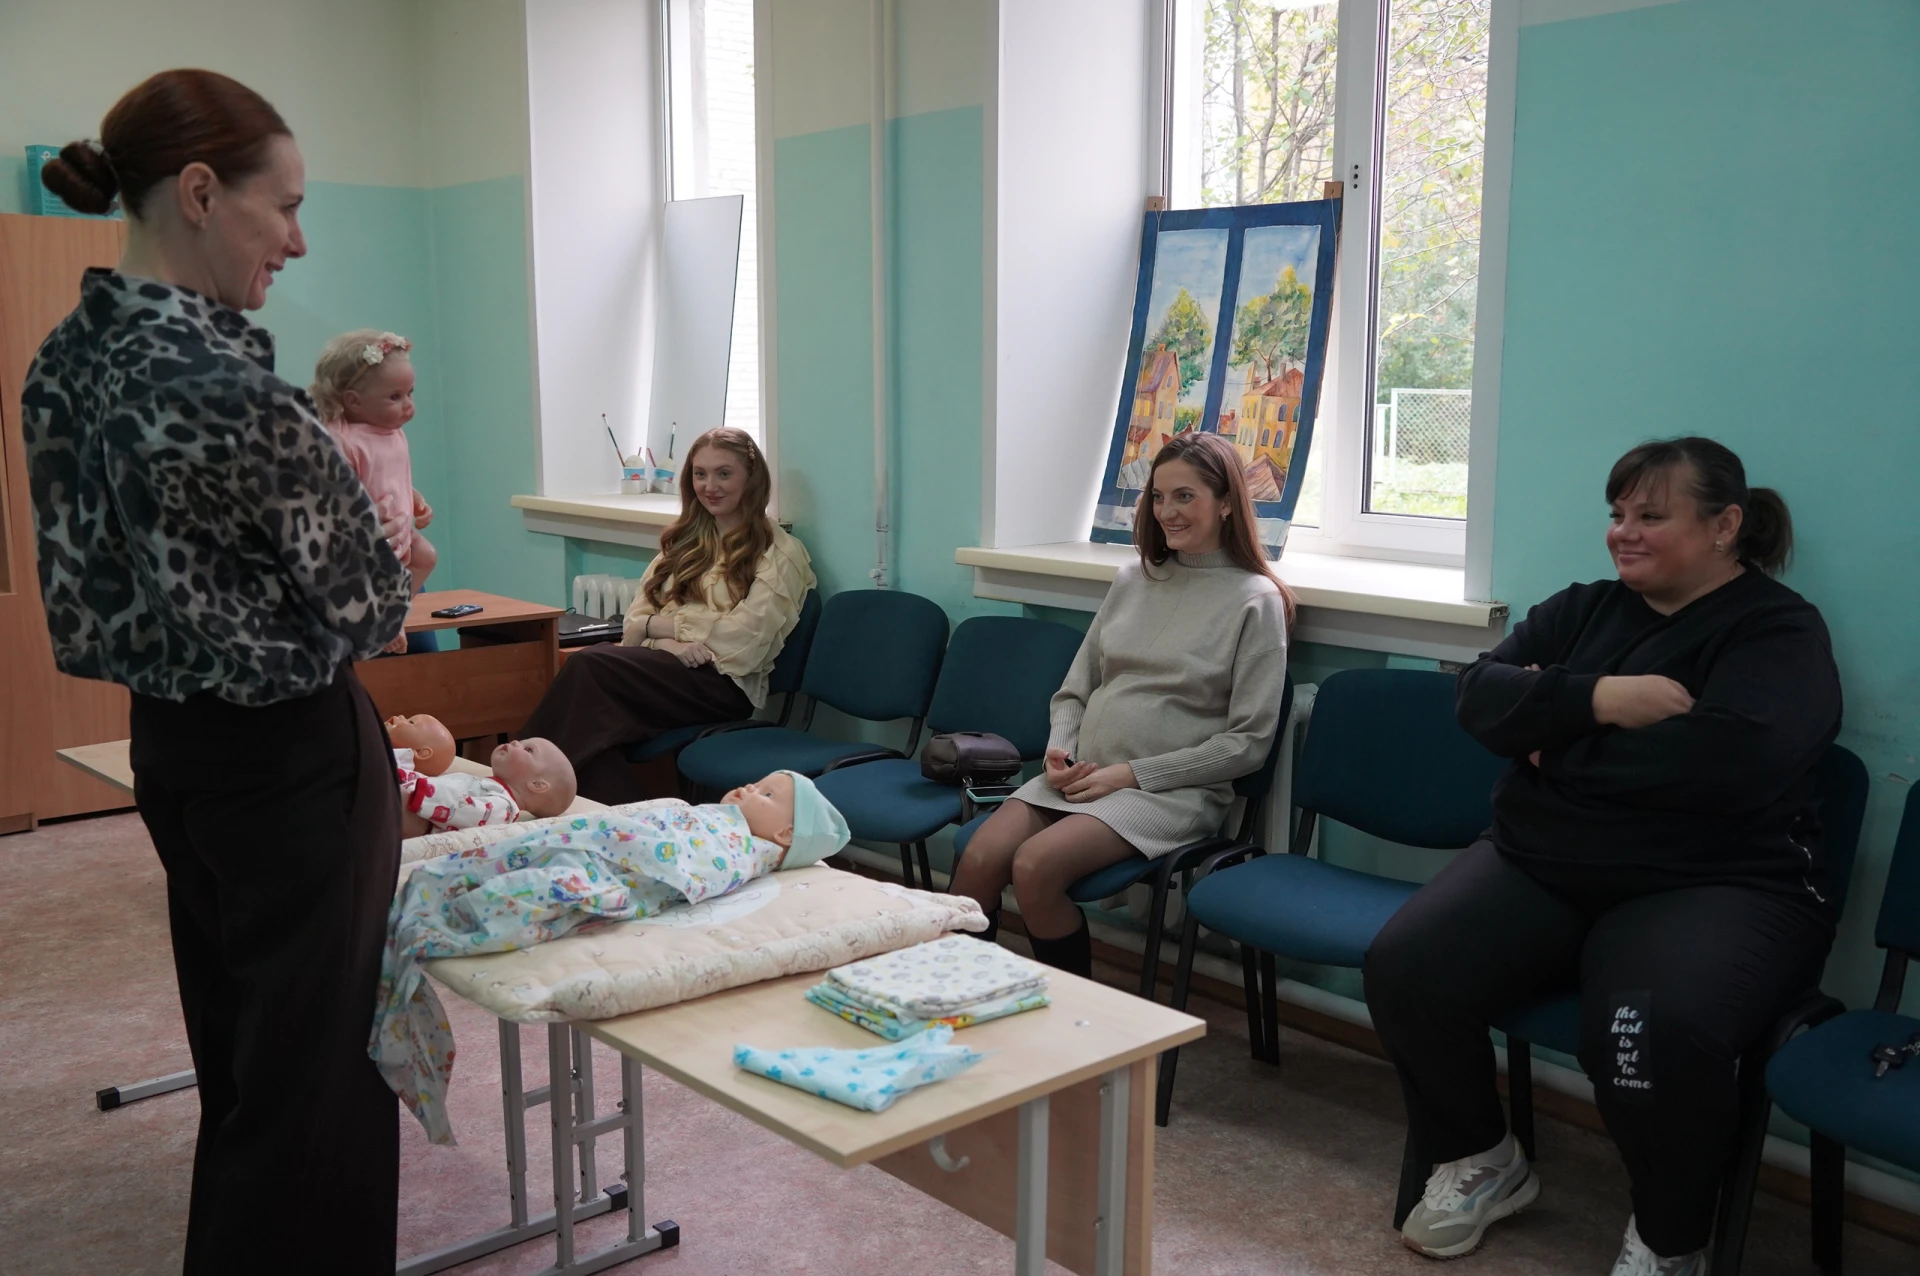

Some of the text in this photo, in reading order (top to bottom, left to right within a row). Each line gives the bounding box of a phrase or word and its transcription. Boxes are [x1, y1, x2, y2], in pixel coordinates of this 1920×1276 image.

[1615, 1006, 1639, 1019] the
[1611, 1020, 1643, 1034] best
[1619, 1036, 1633, 1048] is
[1616, 1050, 1639, 1066] yet
[1622, 1063, 1636, 1075] to
[1613, 1077, 1651, 1089] come
